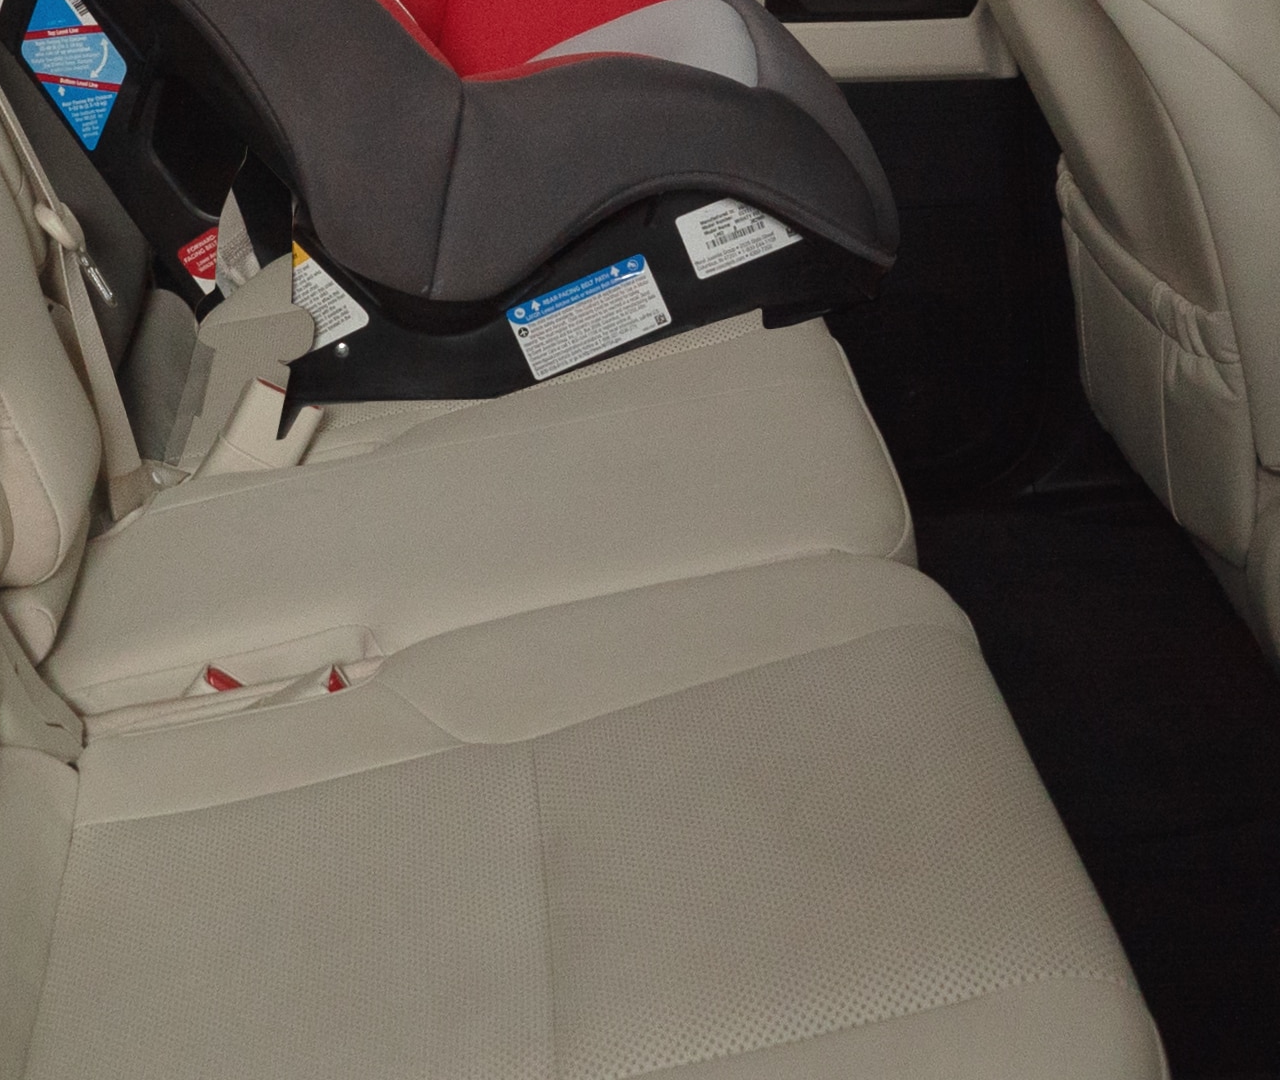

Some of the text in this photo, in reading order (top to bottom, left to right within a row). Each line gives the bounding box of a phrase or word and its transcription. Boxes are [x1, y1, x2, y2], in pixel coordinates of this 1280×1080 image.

[59, 77, 76, 85] Bottom
[183, 240, 219, 263] FACING BELT
[186, 233, 217, 254] FORWARD-
[196, 256, 210, 266] Lower
[581, 279, 594, 289] BELT
[594, 272, 610, 283] PATH
